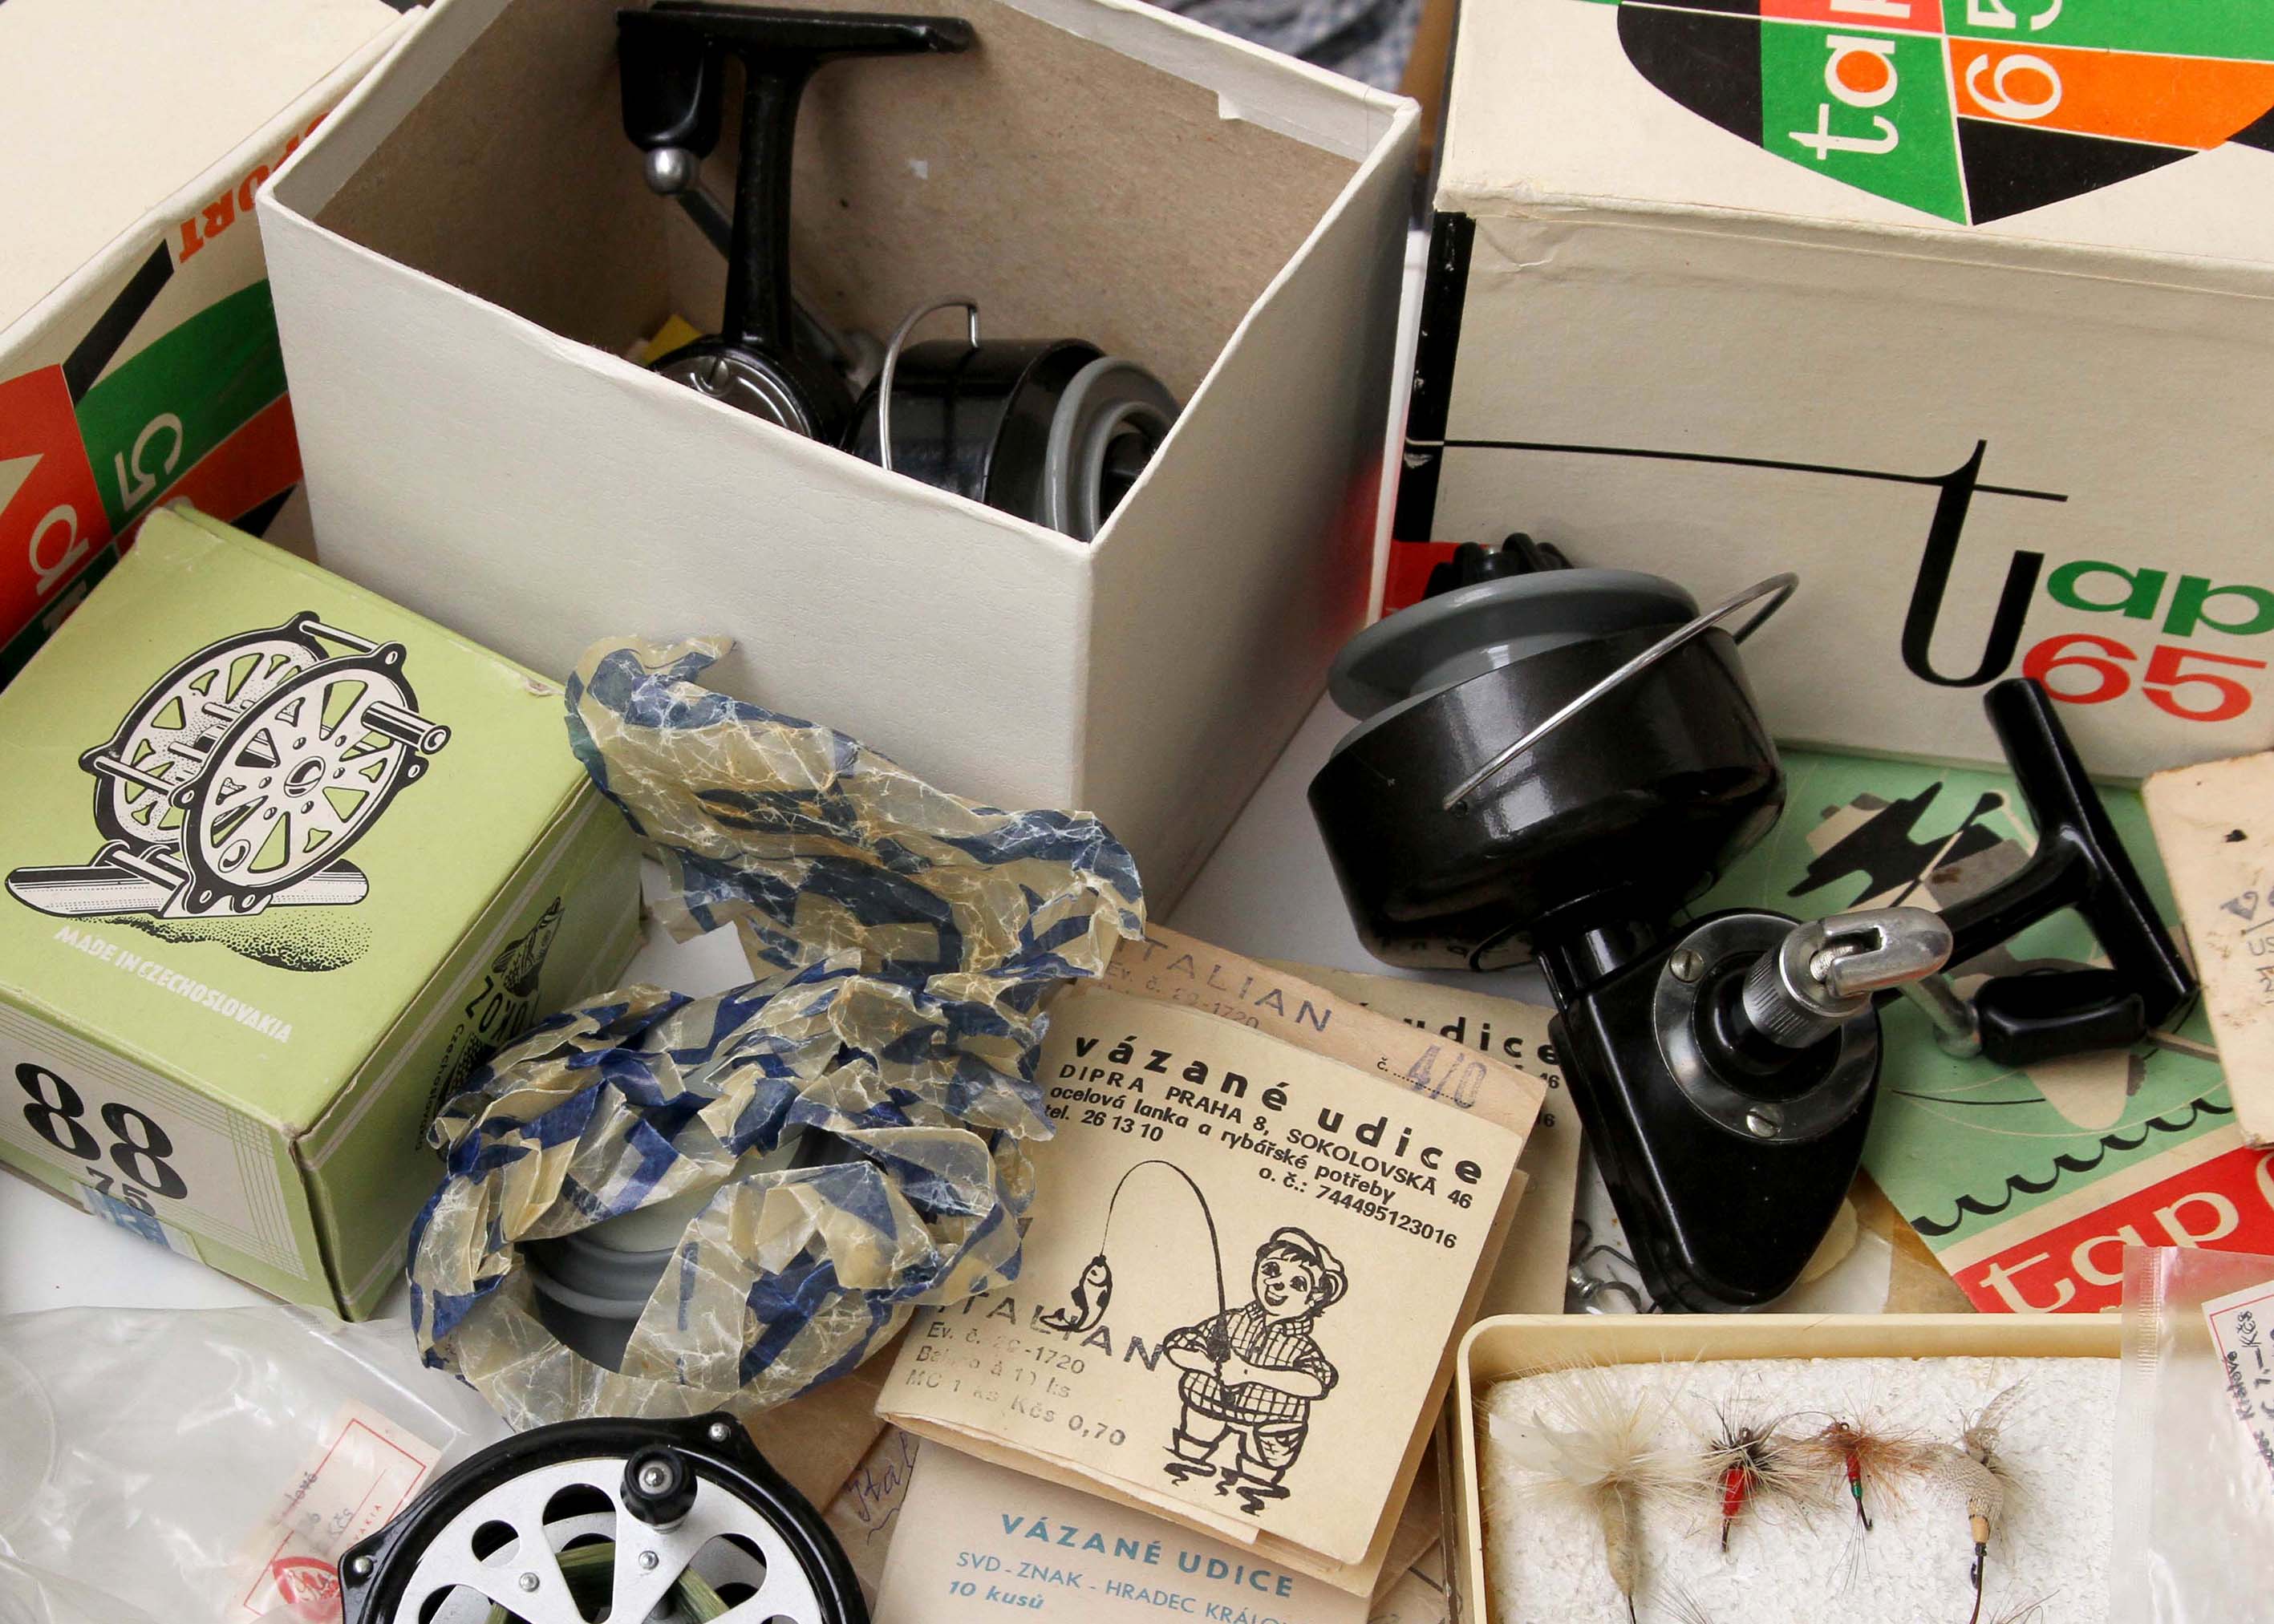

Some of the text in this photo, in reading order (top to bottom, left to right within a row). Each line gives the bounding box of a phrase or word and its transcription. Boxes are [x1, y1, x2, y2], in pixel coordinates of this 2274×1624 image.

[1789, 0, 1914, 160] ta
[2022, 633, 2268, 722] 65
[53, 925, 293, 1043] MADE IN CZECHOSLOVAKIA
[1117, 936, 1332, 1032] TALIAN
[14, 1063, 188, 1200] 88
[1044, 1104, 1164, 1142] tel. 26 13 10
[1049, 1087, 1397, 1206] ocelová lanka a rybářské potřeby
[1059, 1063, 1145, 1093] DIPRA
[1165, 1086, 1242, 1124] PRAHA
[1253, 1116, 1271, 1136] 8,
[1447, 1189, 1473, 1209] 46
[1074, 1035, 1482, 1185] vázané udice
[85, 1165, 156, 1218] 75
[1259, 1167, 1458, 1249] o. č.: 744495123016
[926, 1321, 953, 1340] Ev.
[938, 1291, 1164, 1372] TALIAN
[1068, 1414, 1127, 1447] 0,70
[948, 1580, 977, 1598] 10
[955, 1551, 1001, 1573] SVD
[1016, 1561, 1084, 1590] ZNAK
[1105, 1579, 1198, 1614] HRADEC
[1002, 1513, 1295, 1598] VÁZANÉ UDICE
